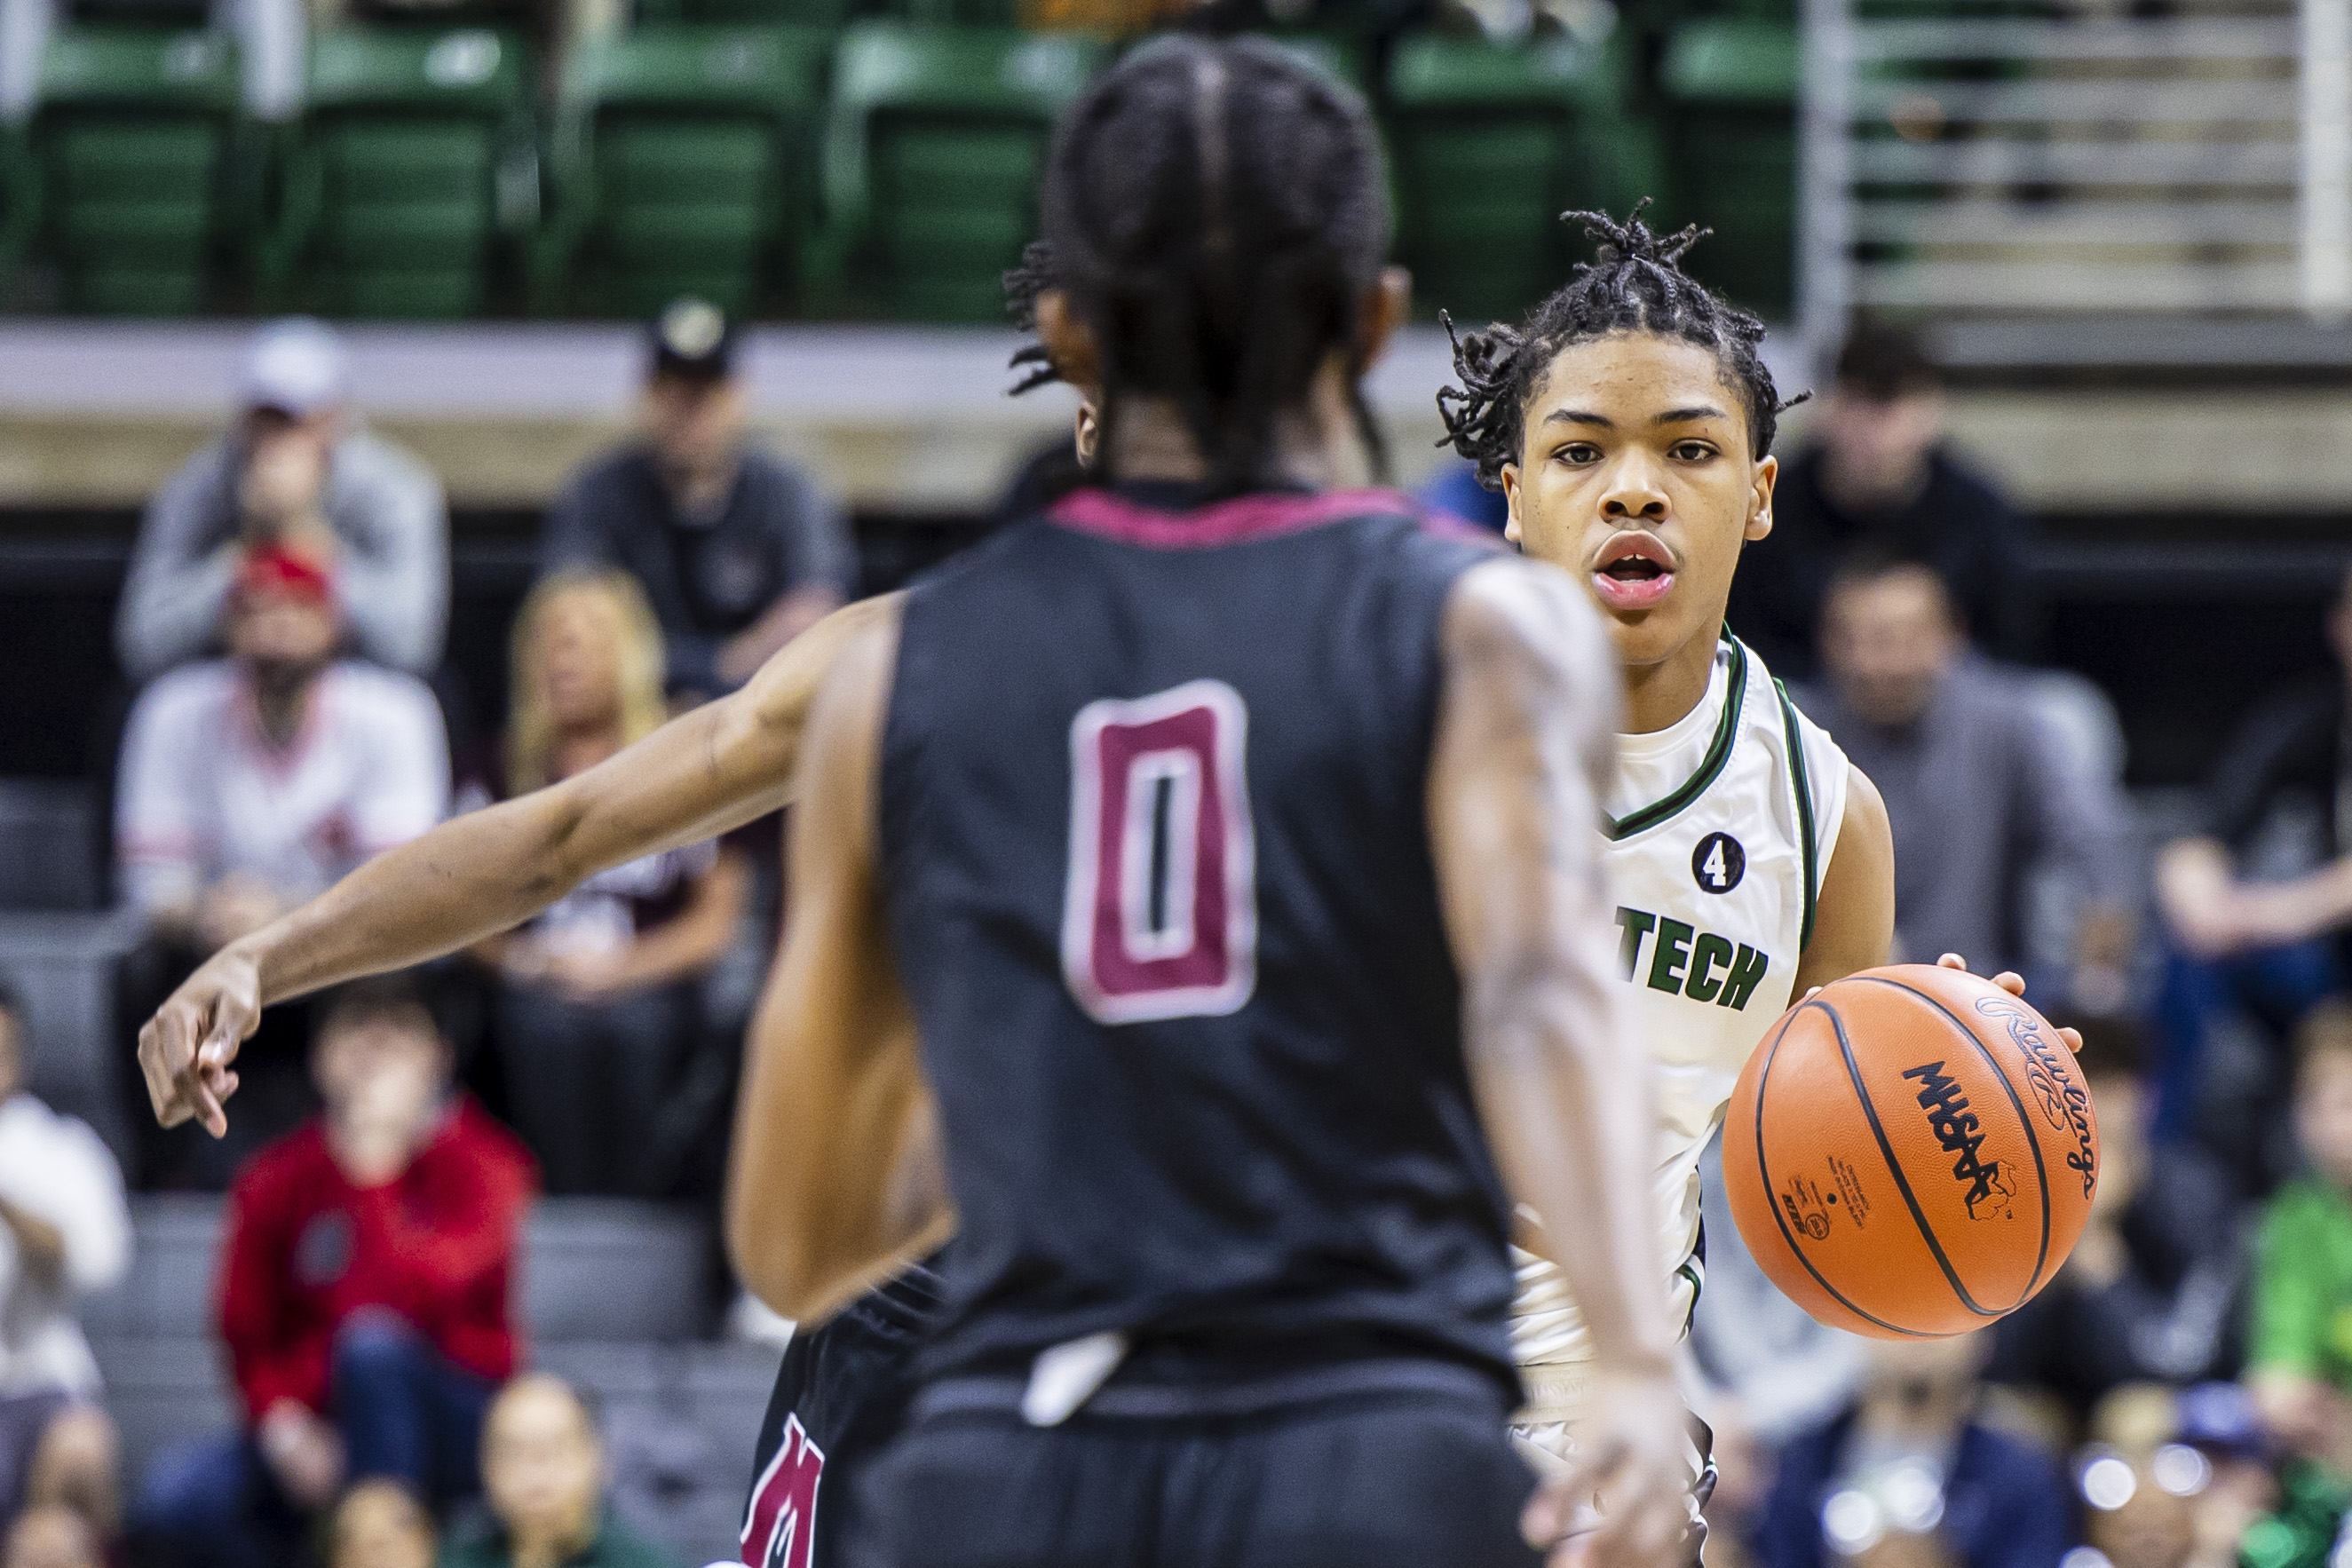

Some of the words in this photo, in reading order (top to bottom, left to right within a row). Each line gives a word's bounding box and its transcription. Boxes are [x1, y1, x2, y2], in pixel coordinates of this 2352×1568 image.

[1061, 678, 1256, 1026] 0
[1702, 839, 1727, 887] 4
[1614, 905, 1769, 1012] TECH
[1902, 1060, 2000, 1208] MHSAA
[1976, 996, 2095, 1200] Rawlings
